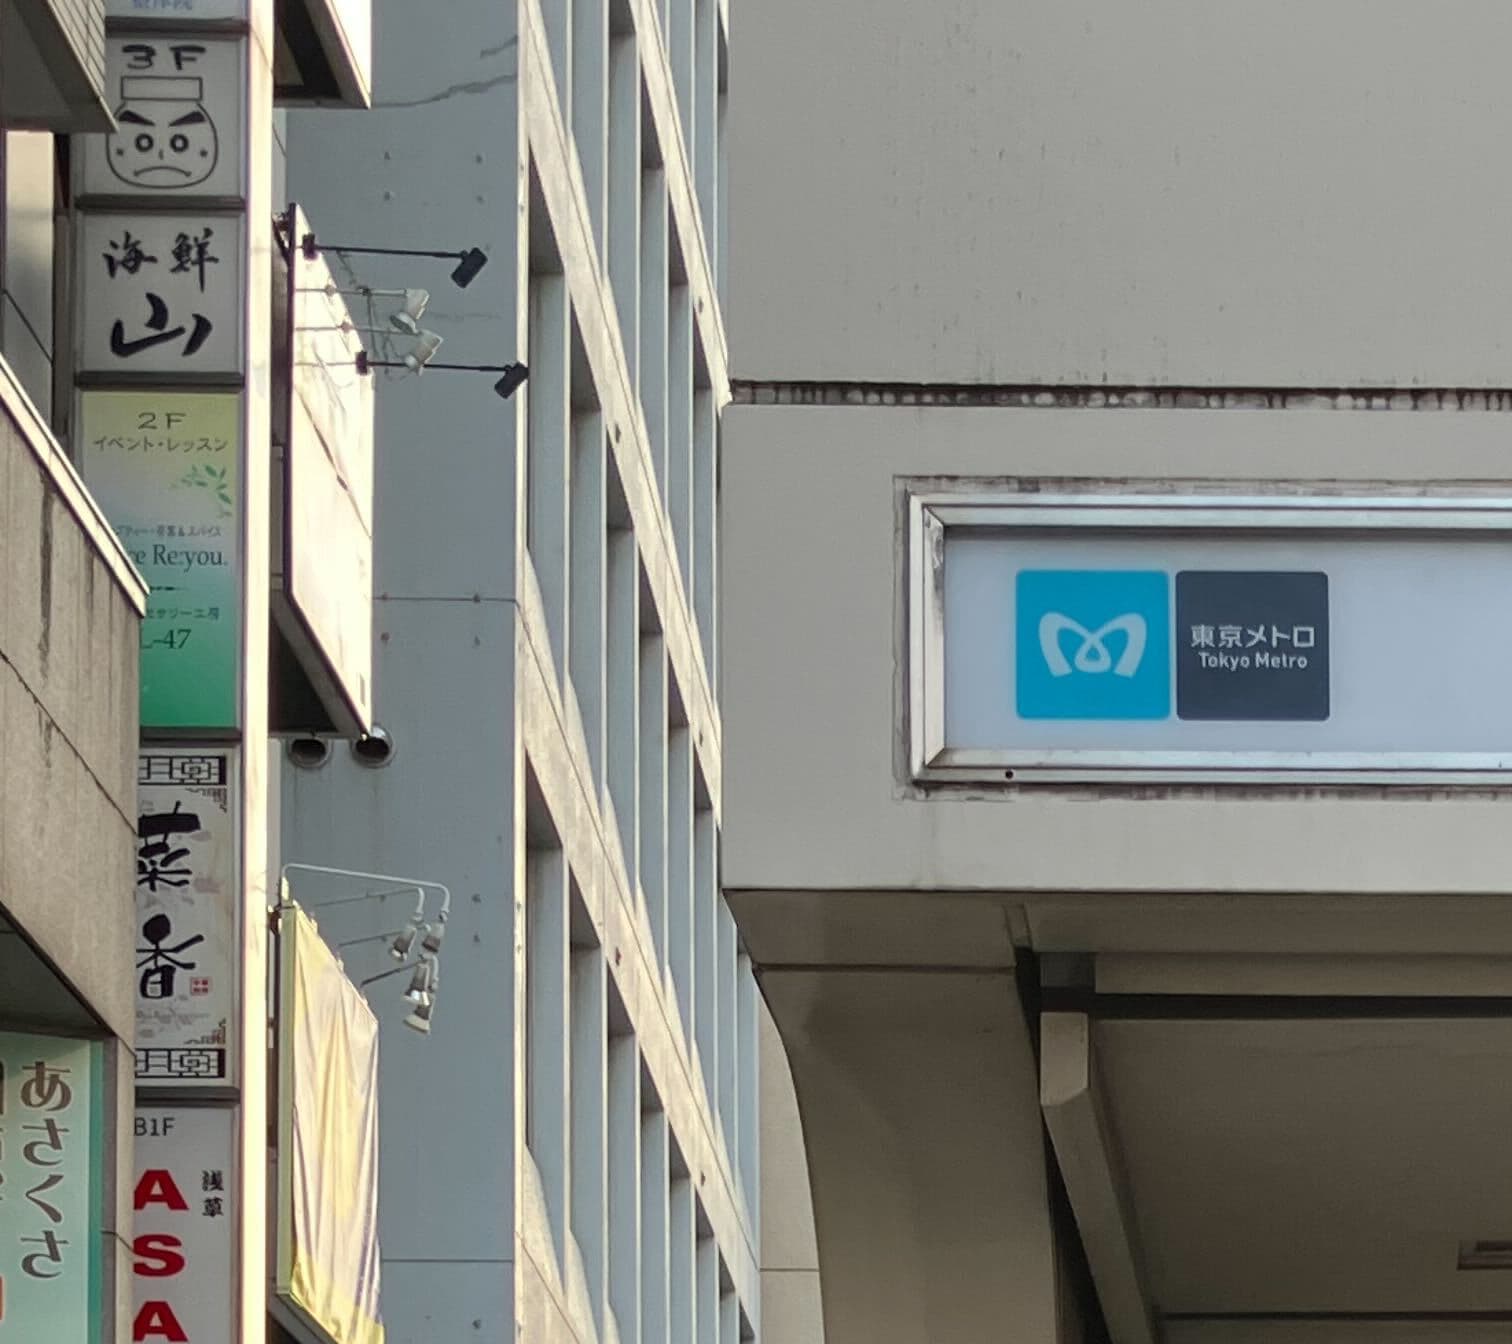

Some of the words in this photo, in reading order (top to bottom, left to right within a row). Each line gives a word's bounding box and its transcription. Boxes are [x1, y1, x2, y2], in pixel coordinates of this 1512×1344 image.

[122, 44, 206, 70] 3F
[103, 230, 220, 292] 海鮮
[111, 292, 212, 357] 山
[137, 412, 186, 429] 2F
[1190, 624, 1315, 649] 東京メトロ
[1198, 651, 1250, 672] Tokyo
[1255, 651, 1308, 670] Metro
[133, 1118, 175, 1136] B1F
[20, 1061, 71, 1278] あさくさ
